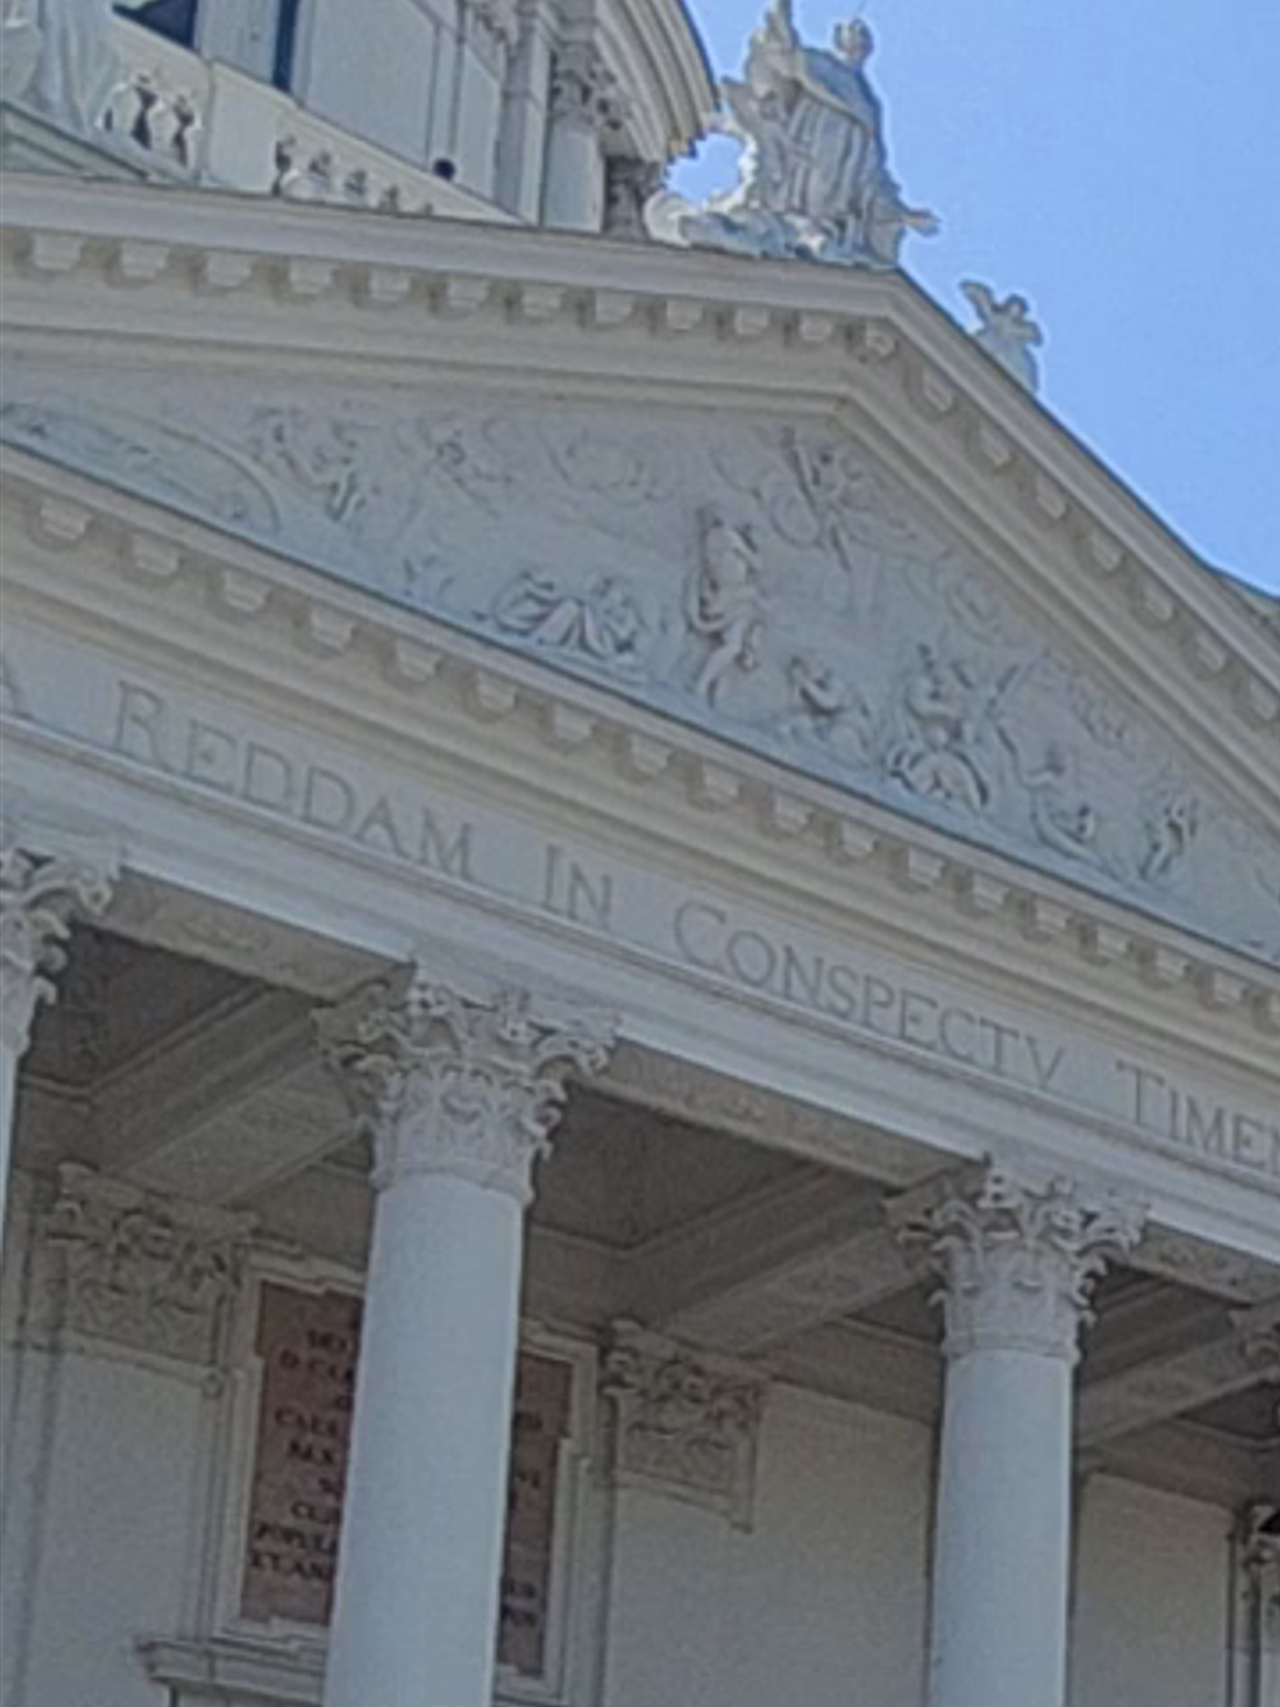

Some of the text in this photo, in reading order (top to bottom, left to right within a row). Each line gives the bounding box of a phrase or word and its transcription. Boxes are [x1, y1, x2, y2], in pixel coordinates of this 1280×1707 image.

[112, 679, 475, 882] REDDAM
[543, 845, 612, 929] IN
[673, 900, 1064, 1091] CONSPECTV
